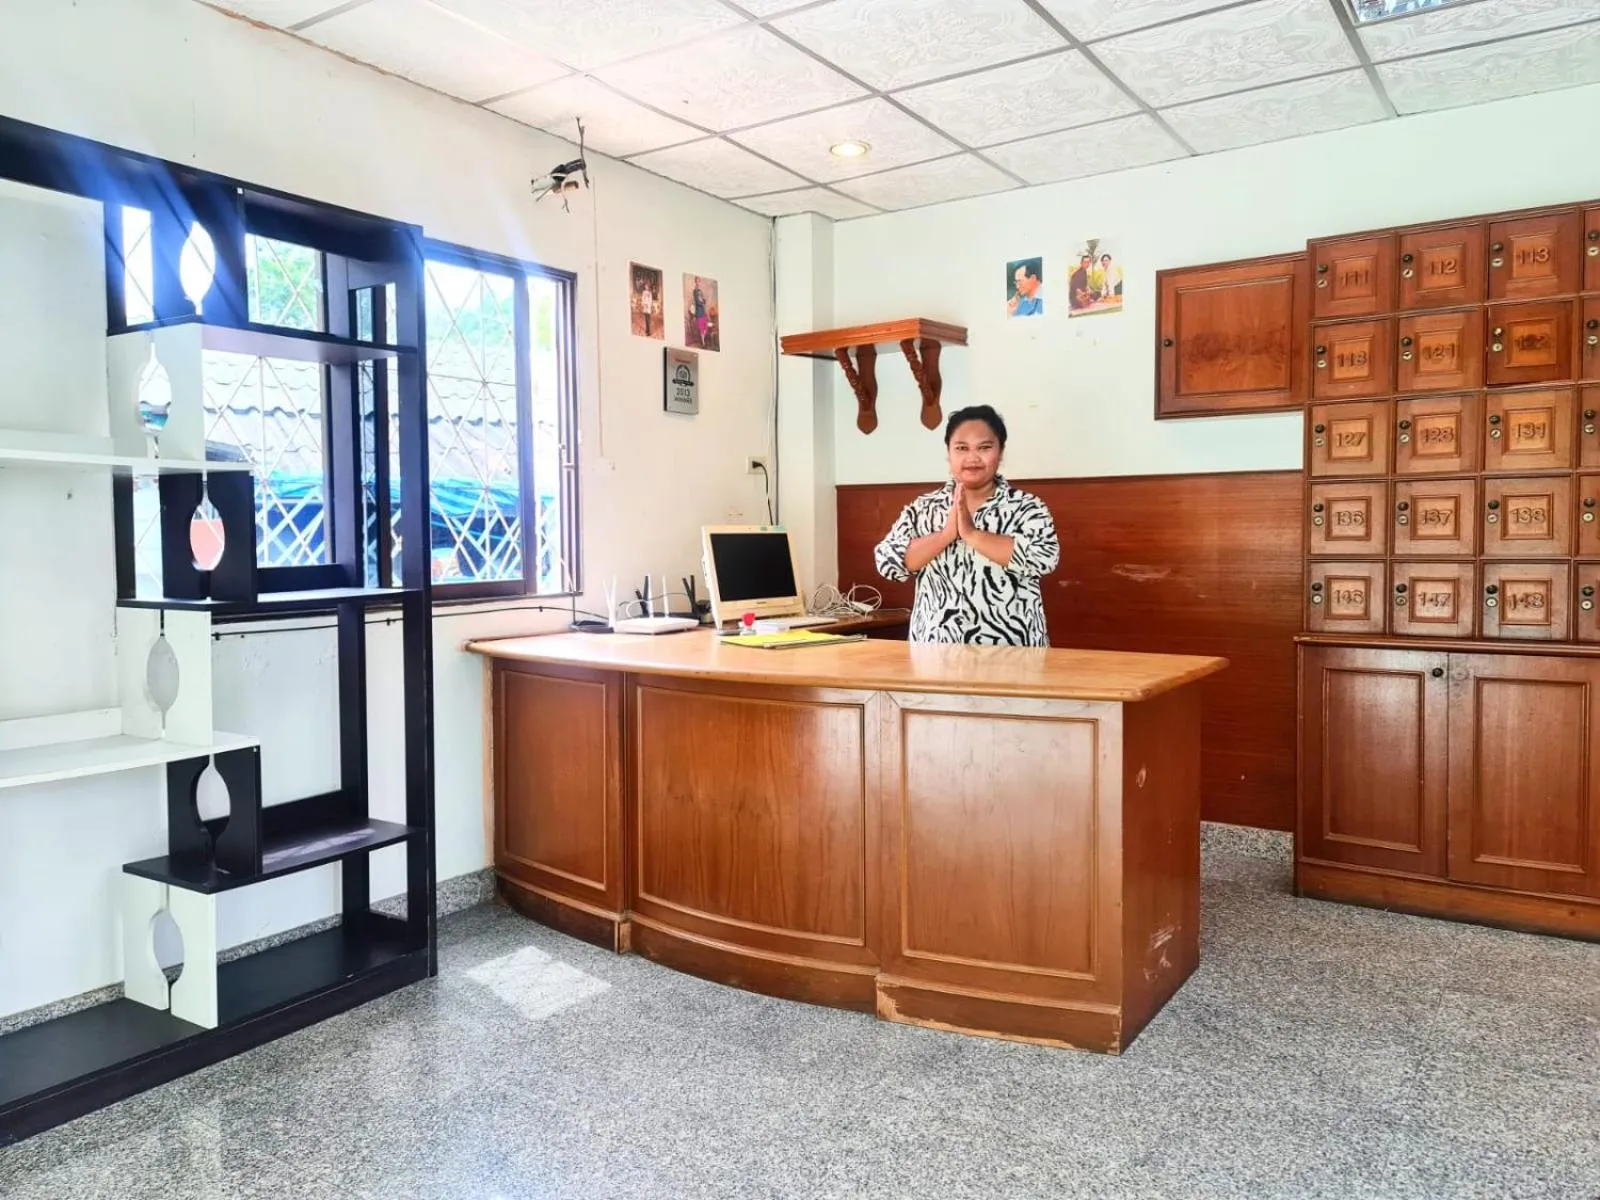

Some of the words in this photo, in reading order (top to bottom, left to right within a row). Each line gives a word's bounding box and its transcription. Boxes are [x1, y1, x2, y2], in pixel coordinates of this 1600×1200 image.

[1518, 246, 1550, 266] 113
[1429, 258, 1457, 276] 112
[1340, 269, 1369, 287] 111
[1336, 432, 1366, 448] 127
[1516, 422, 1547, 440] 131
[1422, 508, 1454, 525] 137
[1417, 591, 1452, 607] 147
